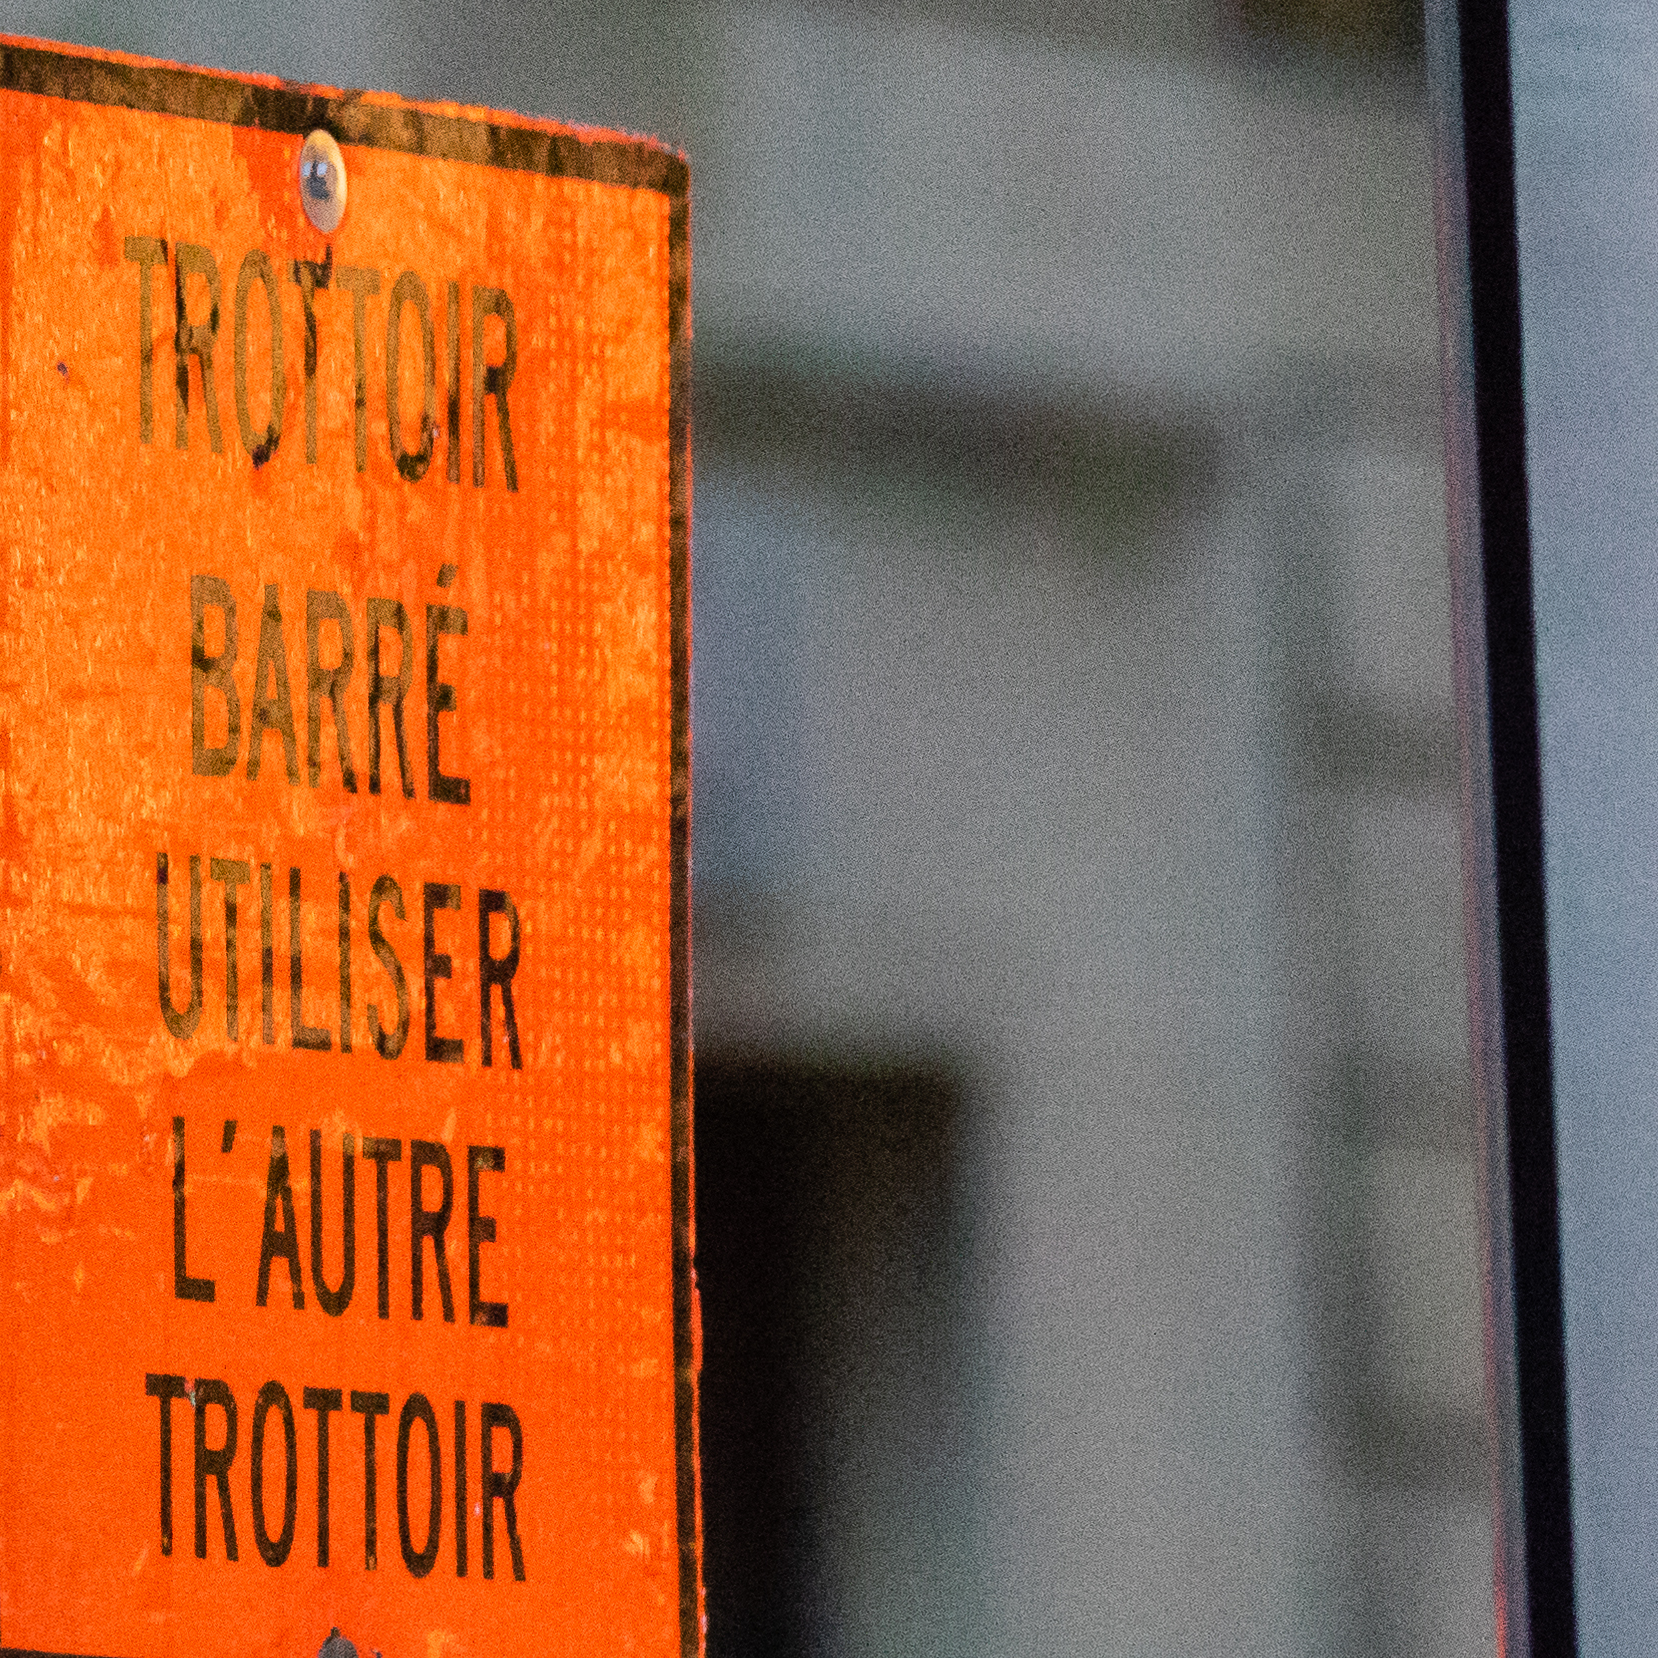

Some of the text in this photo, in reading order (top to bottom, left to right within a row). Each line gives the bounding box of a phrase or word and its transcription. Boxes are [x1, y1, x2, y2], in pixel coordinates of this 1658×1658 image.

[123, 235, 520, 493] TROTTOIR
[190, 563, 472, 806] BARRÉ
[155, 851, 525, 1071] UTILISER
[171, 1115, 510, 1328] L'AUTRE
[144, 1373, 527, 1582] TROTTOIR
